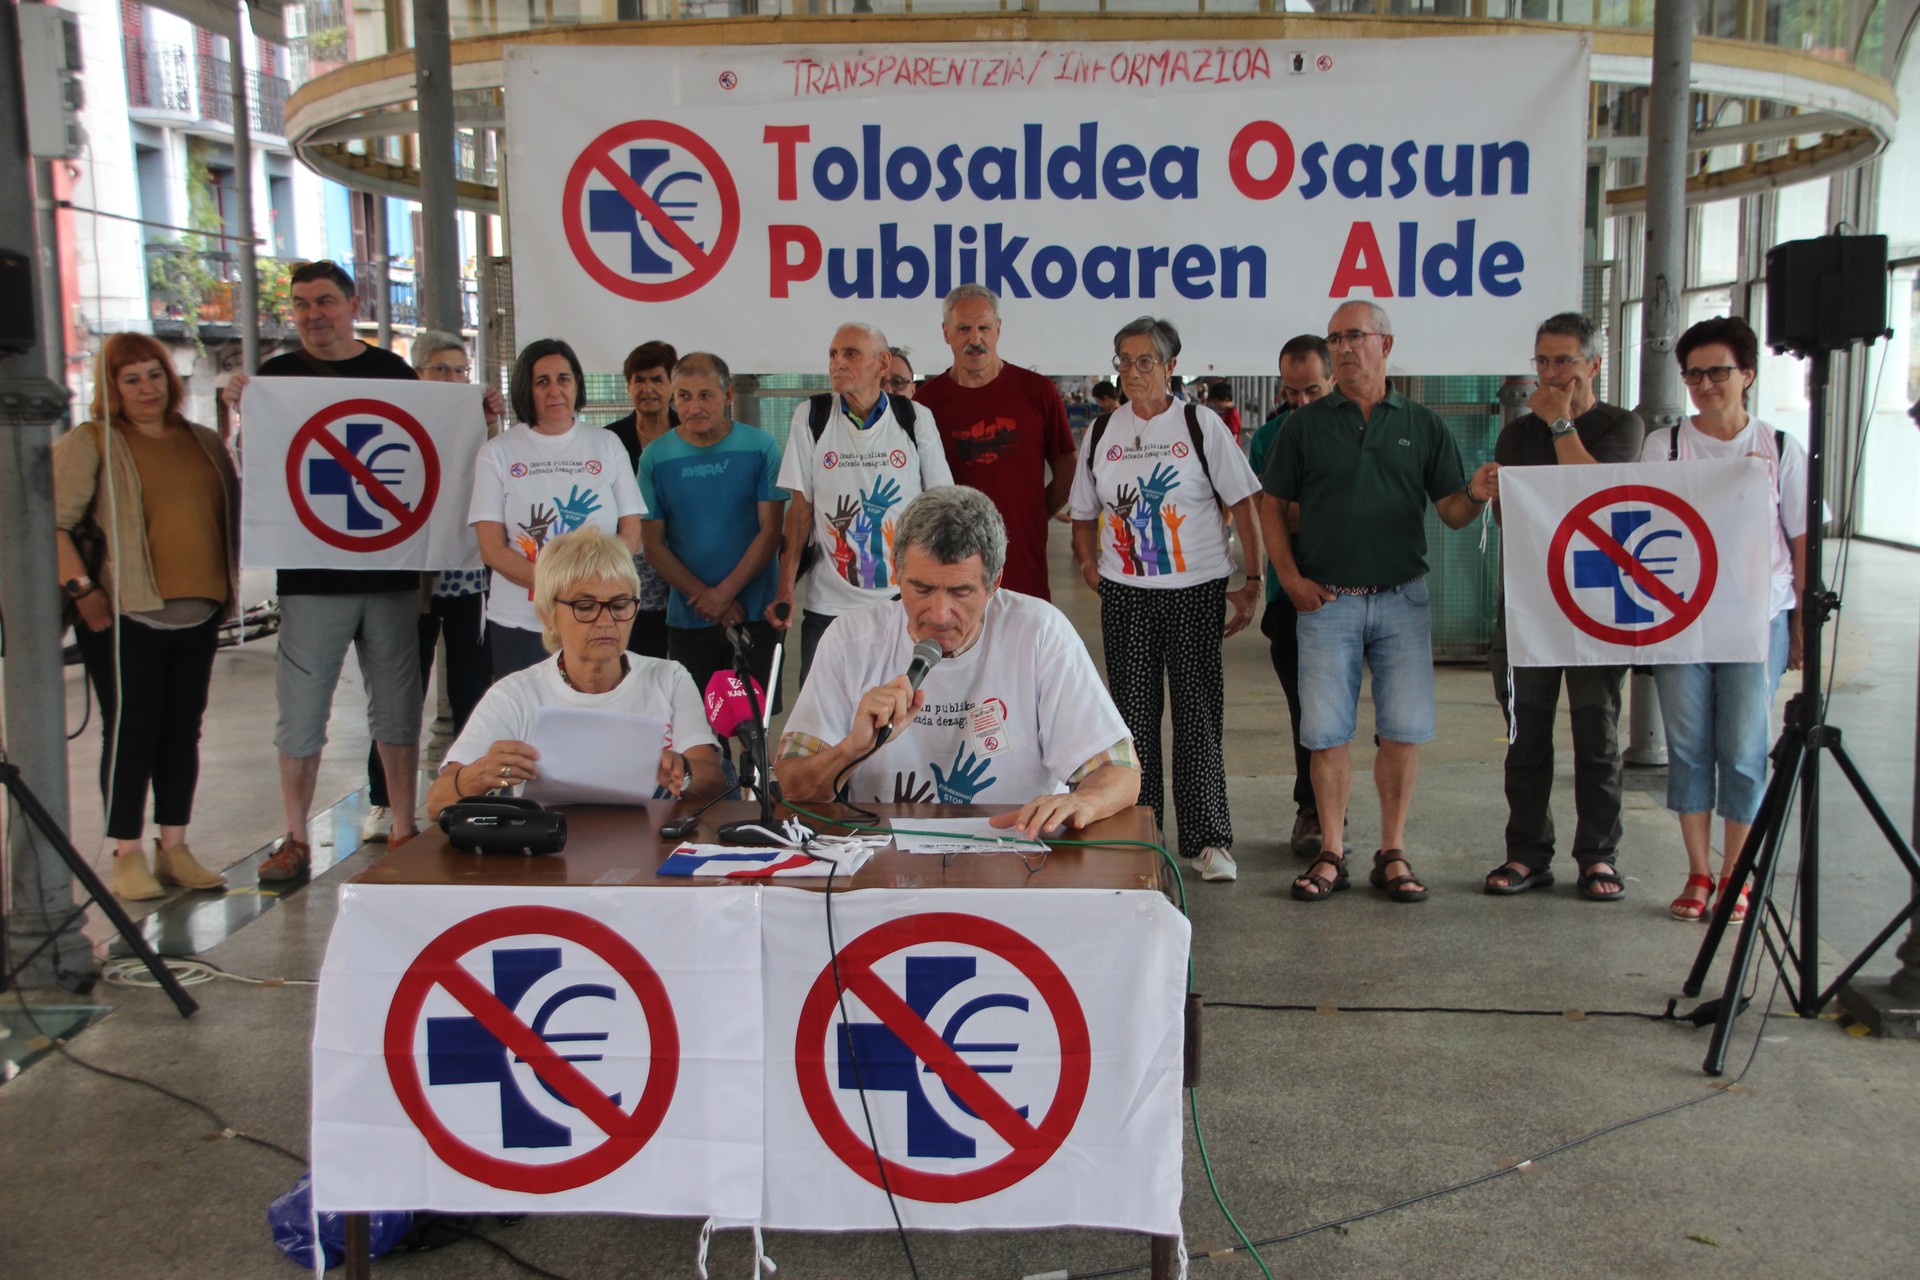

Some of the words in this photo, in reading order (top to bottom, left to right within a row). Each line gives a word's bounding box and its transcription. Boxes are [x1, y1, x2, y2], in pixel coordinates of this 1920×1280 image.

[1054, 47, 1271, 87] INFORMAZIOA
[763, 121, 1200, 201] Tolosaldea
[1228, 120, 1530, 201] Osasun
[768, 222, 1267, 300] Publikoaren
[1329, 218, 1525, 299] Alde
[565, 514, 582, 522] STOP
